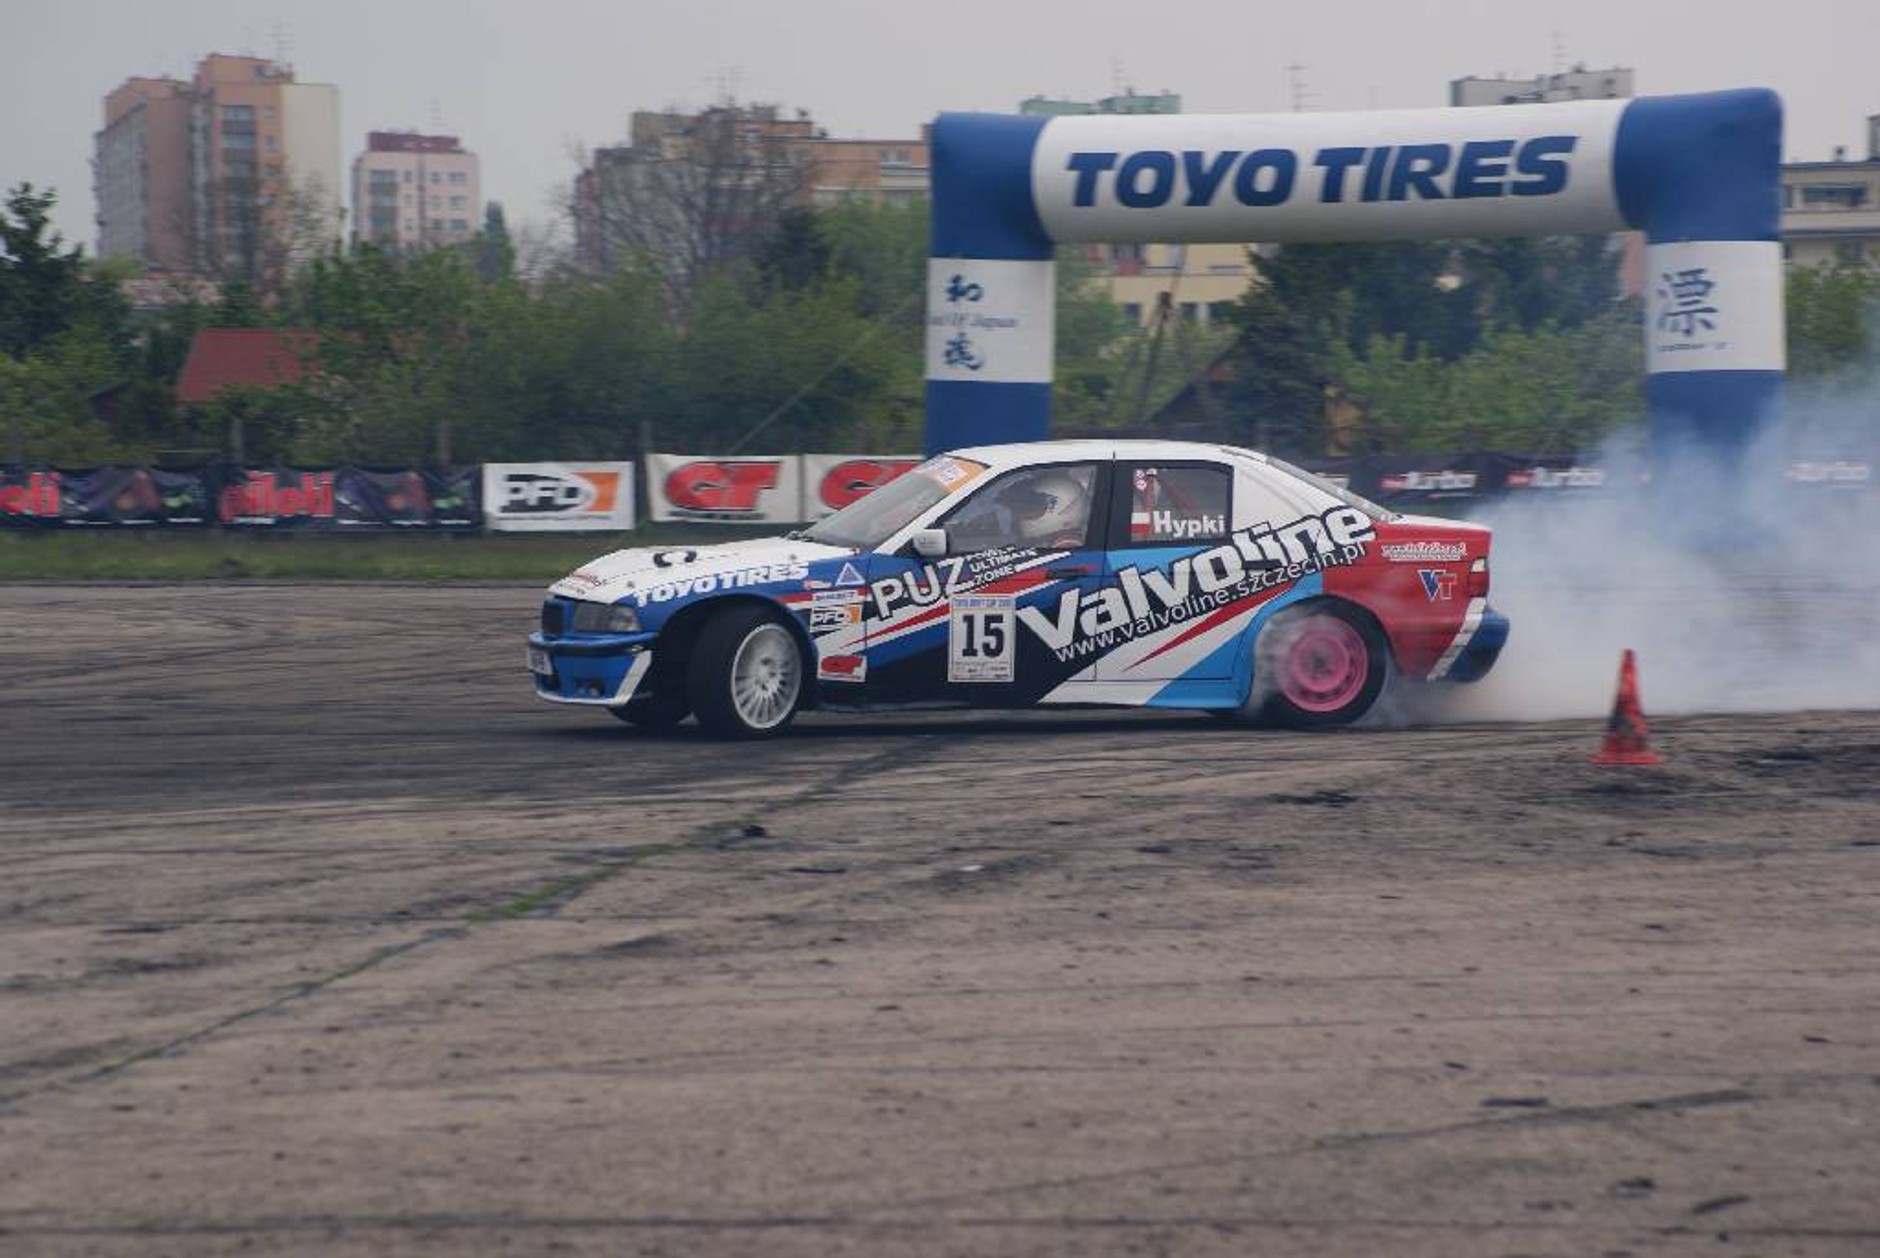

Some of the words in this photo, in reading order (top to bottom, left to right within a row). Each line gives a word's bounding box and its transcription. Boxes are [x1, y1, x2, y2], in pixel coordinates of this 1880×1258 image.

[1066, 148, 1297, 208] TOYO
[1313, 135, 1579, 204] TIRES
[1153, 510, 1225, 538] Hypki
[631, 577, 719, 607] TOYO
[721, 562, 809, 590] TIRES
[871, 556, 974, 618] PUZ
[975, 564, 1015, 586] ZONE
[1015, 505, 1376, 650] Valvoline
[1056, 541, 1366, 663] www.valvoline.szczecin.pl
[962, 614, 1005, 659] 15
